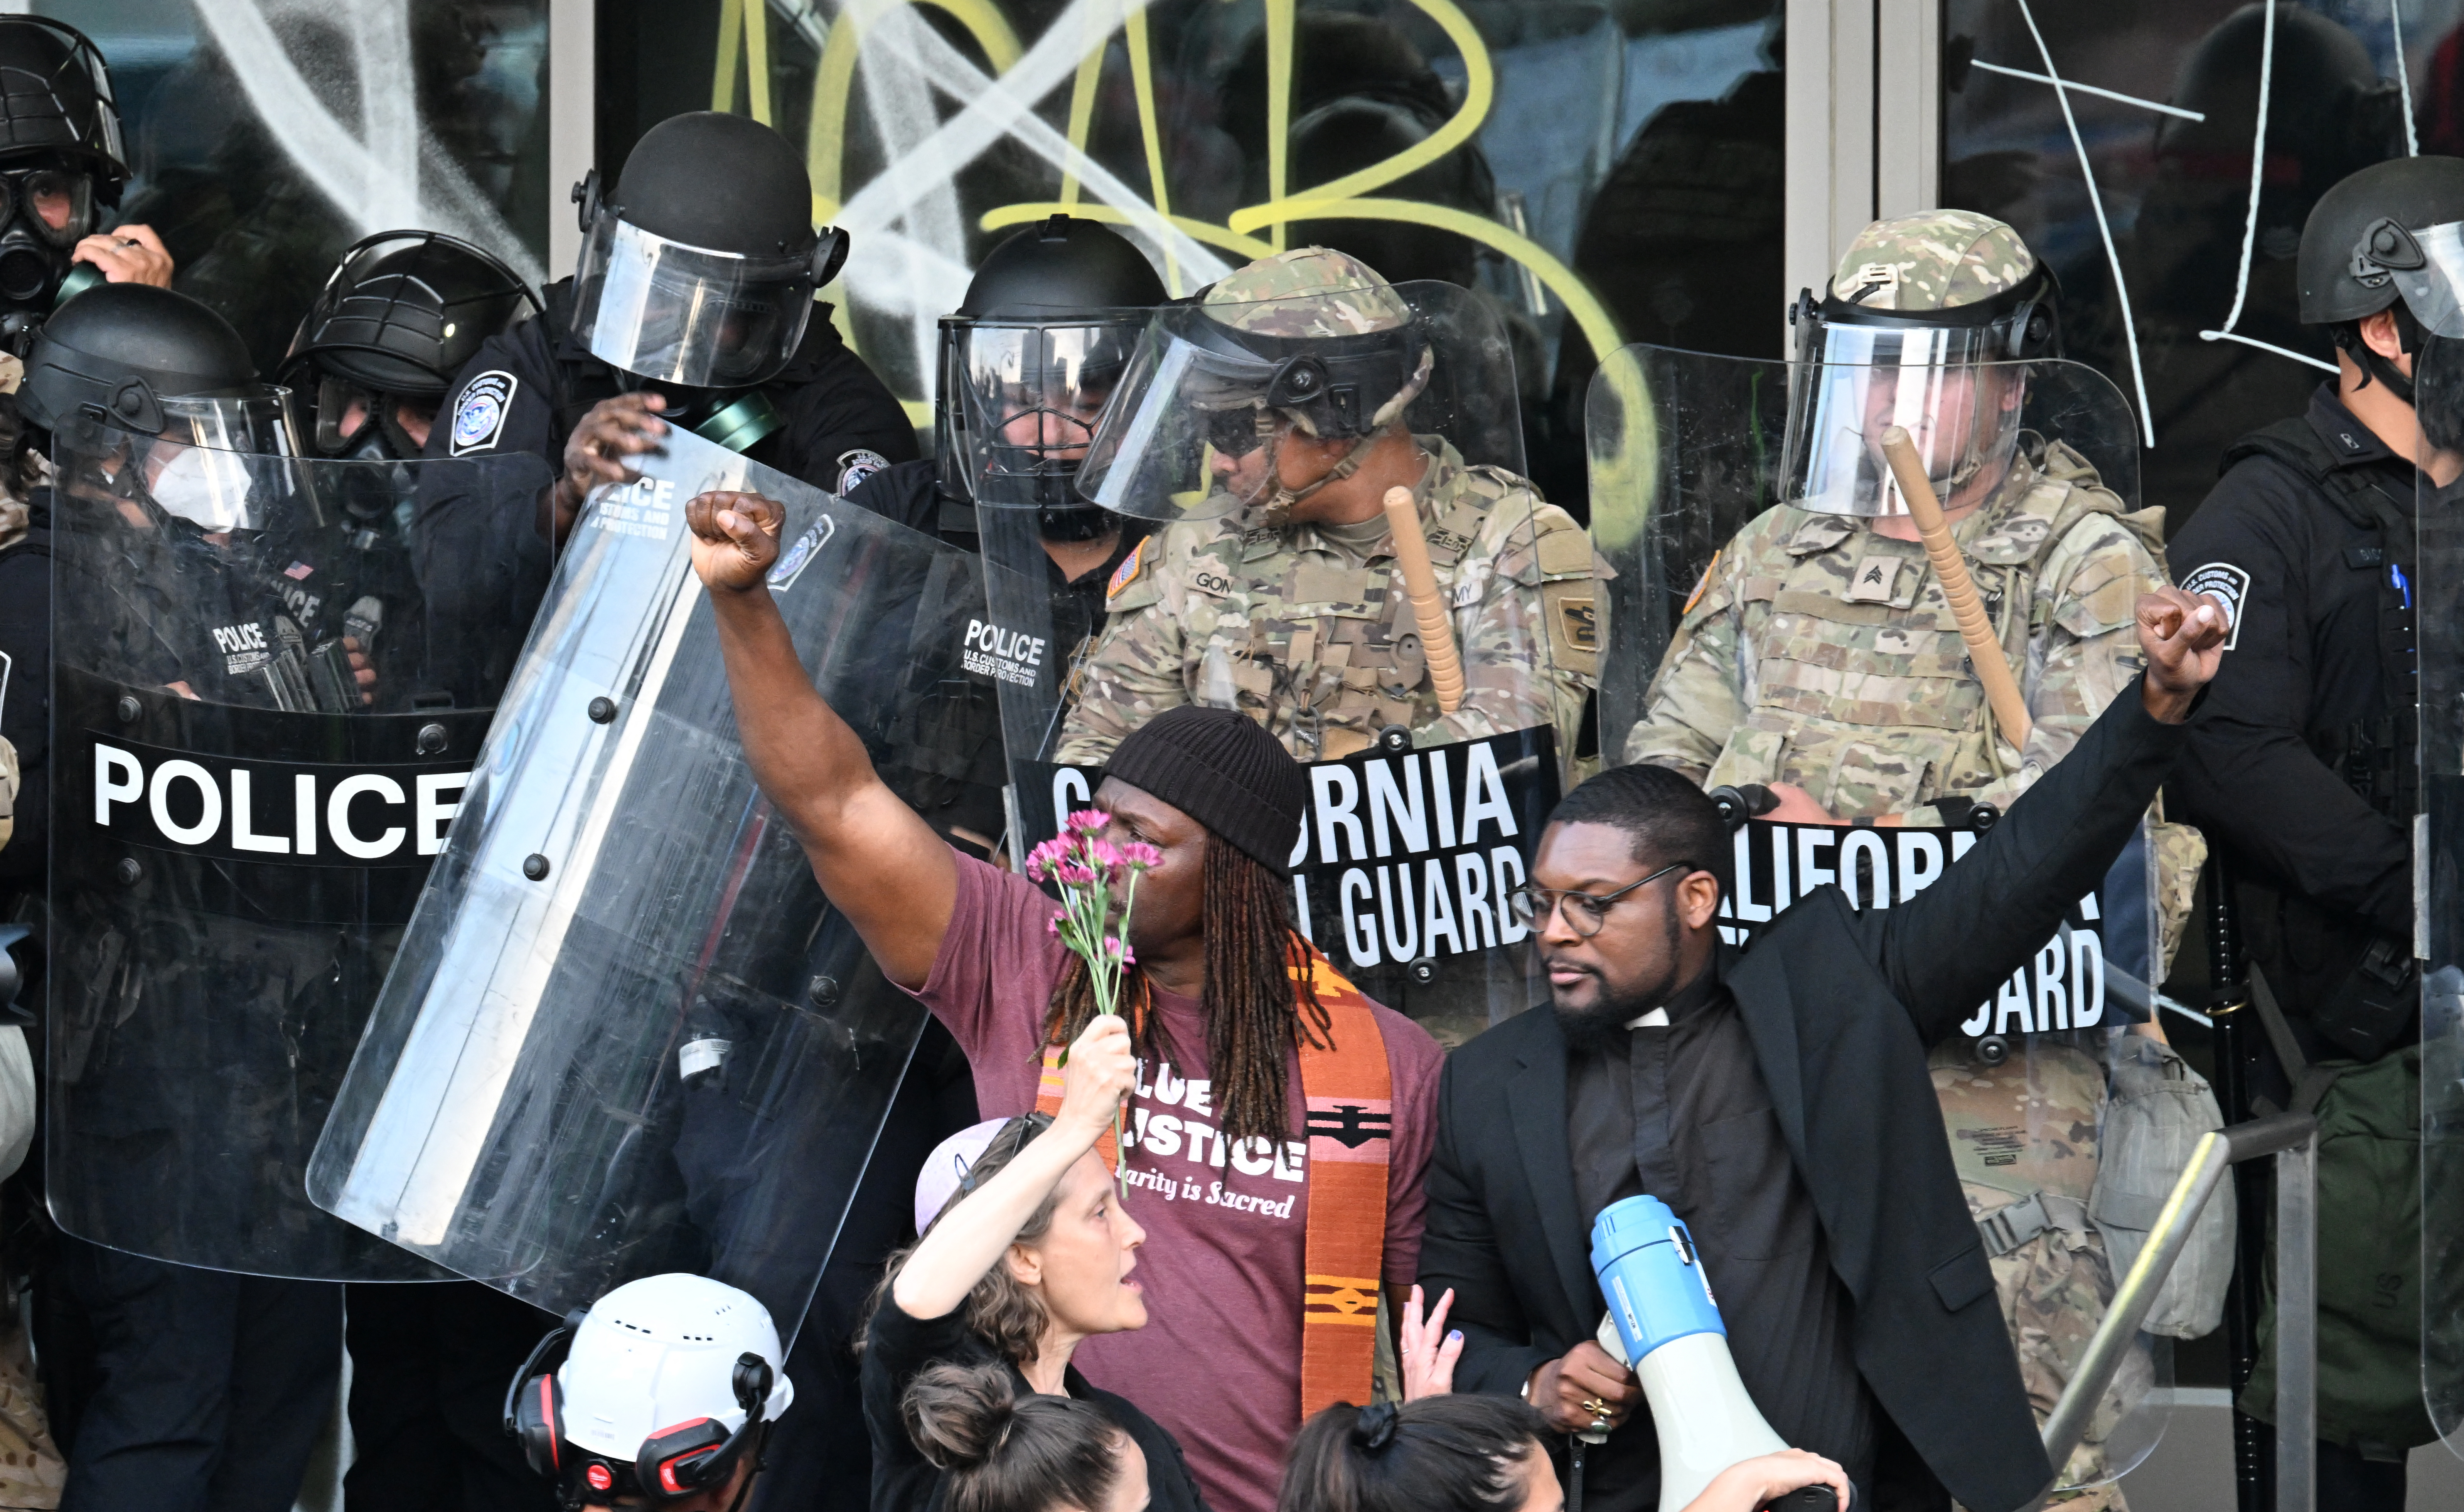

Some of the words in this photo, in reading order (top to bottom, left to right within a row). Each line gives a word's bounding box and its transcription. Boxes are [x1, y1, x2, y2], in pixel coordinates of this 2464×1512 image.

[643, 510, 670, 525] AND
[2198, 570, 2230, 581] CUSTOMS
[2204, 580, 2240, 600] PROTECTION
[212, 622, 268, 653] POLICE
[964, 619, 1045, 666] POLICE
[961, 660, 990, 676] BORDER
[990, 668, 1035, 687] PROTECTION
[979, 654, 1020, 673] CUSTOMS
[1019, 667, 1036, 677] AND
[95, 743, 477, 859] POLICE
[1340, 844, 1529, 968] GUARD
[1960, 929, 2105, 1037] ARD
[1135, 1057, 1212, 1117] LUE
[1181, 1175, 1202, 1201] is
[1205, 1181, 1296, 1219] Sacred
